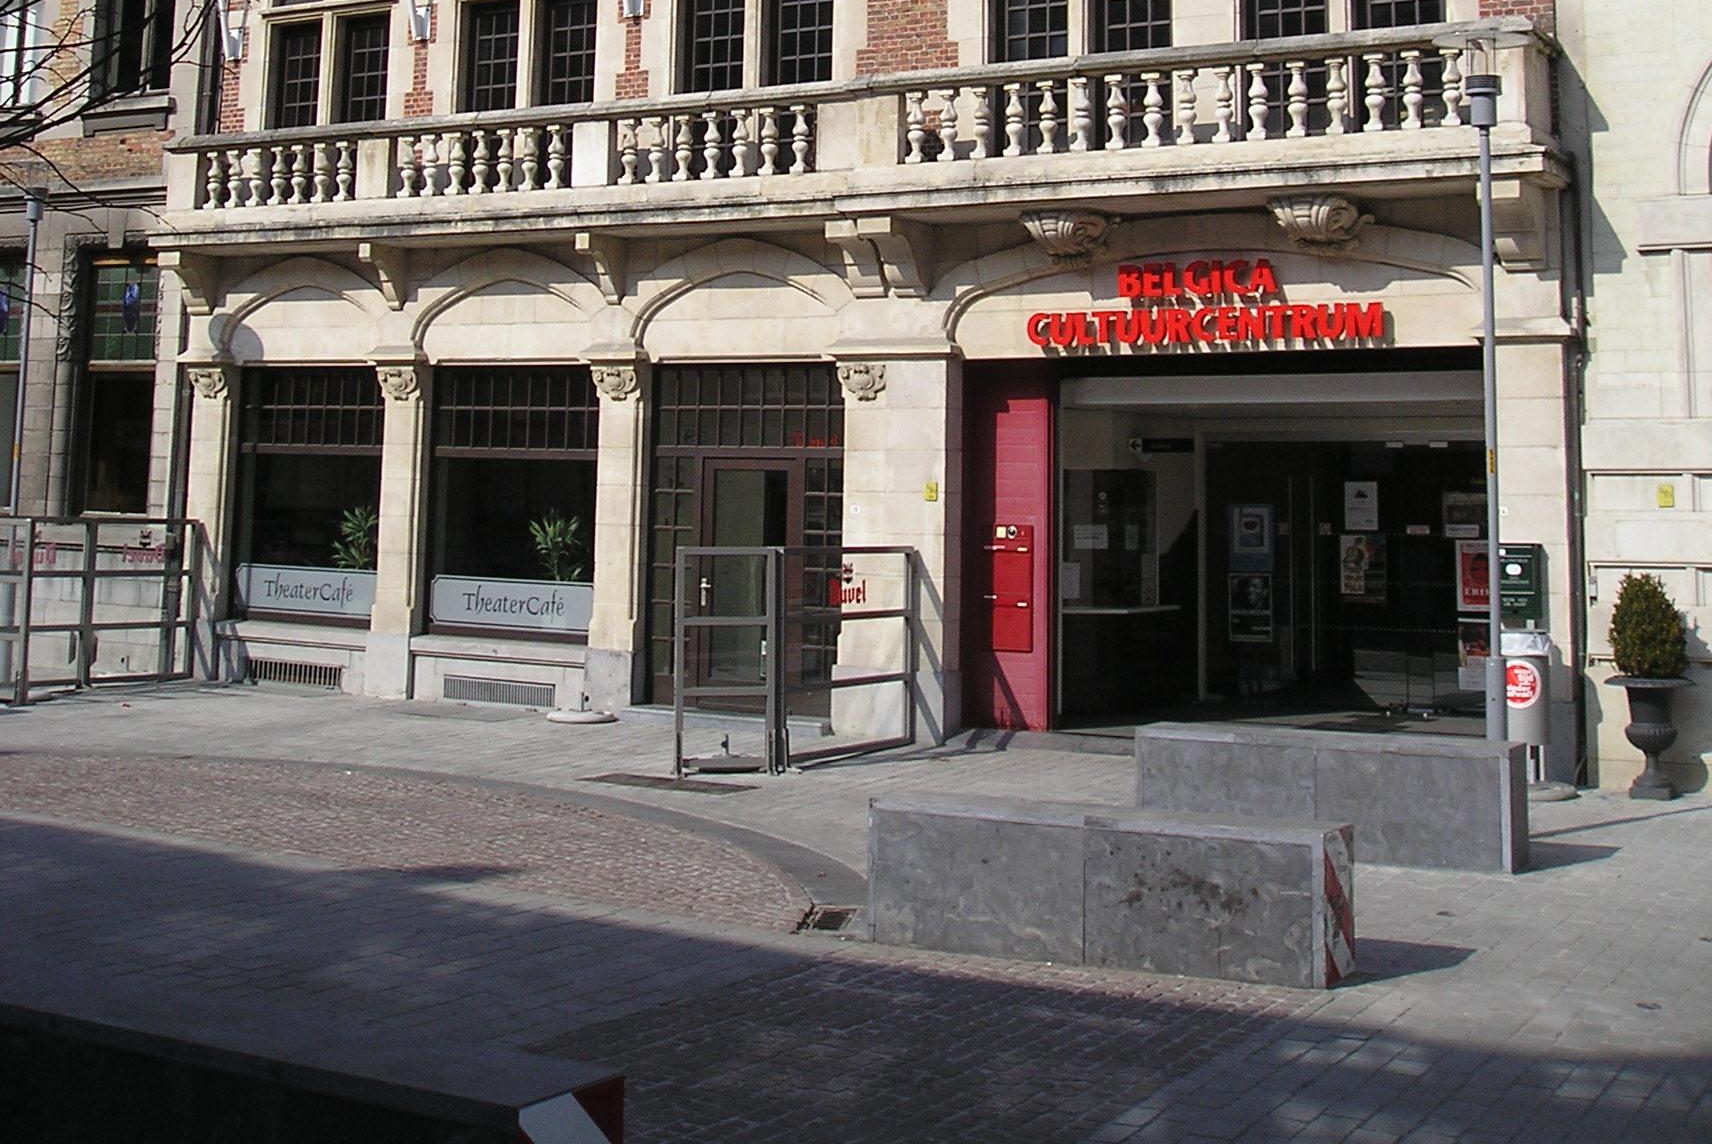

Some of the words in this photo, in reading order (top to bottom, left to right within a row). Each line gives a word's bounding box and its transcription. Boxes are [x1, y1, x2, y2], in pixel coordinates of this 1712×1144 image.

[1117, 258, 1277, 298] BELGICA
[1027, 301, 1384, 346] CULTUURCENTRUM
[264, 572, 353, 609] TheaterCafé
[462, 584, 565, 622] TheaterCafé
